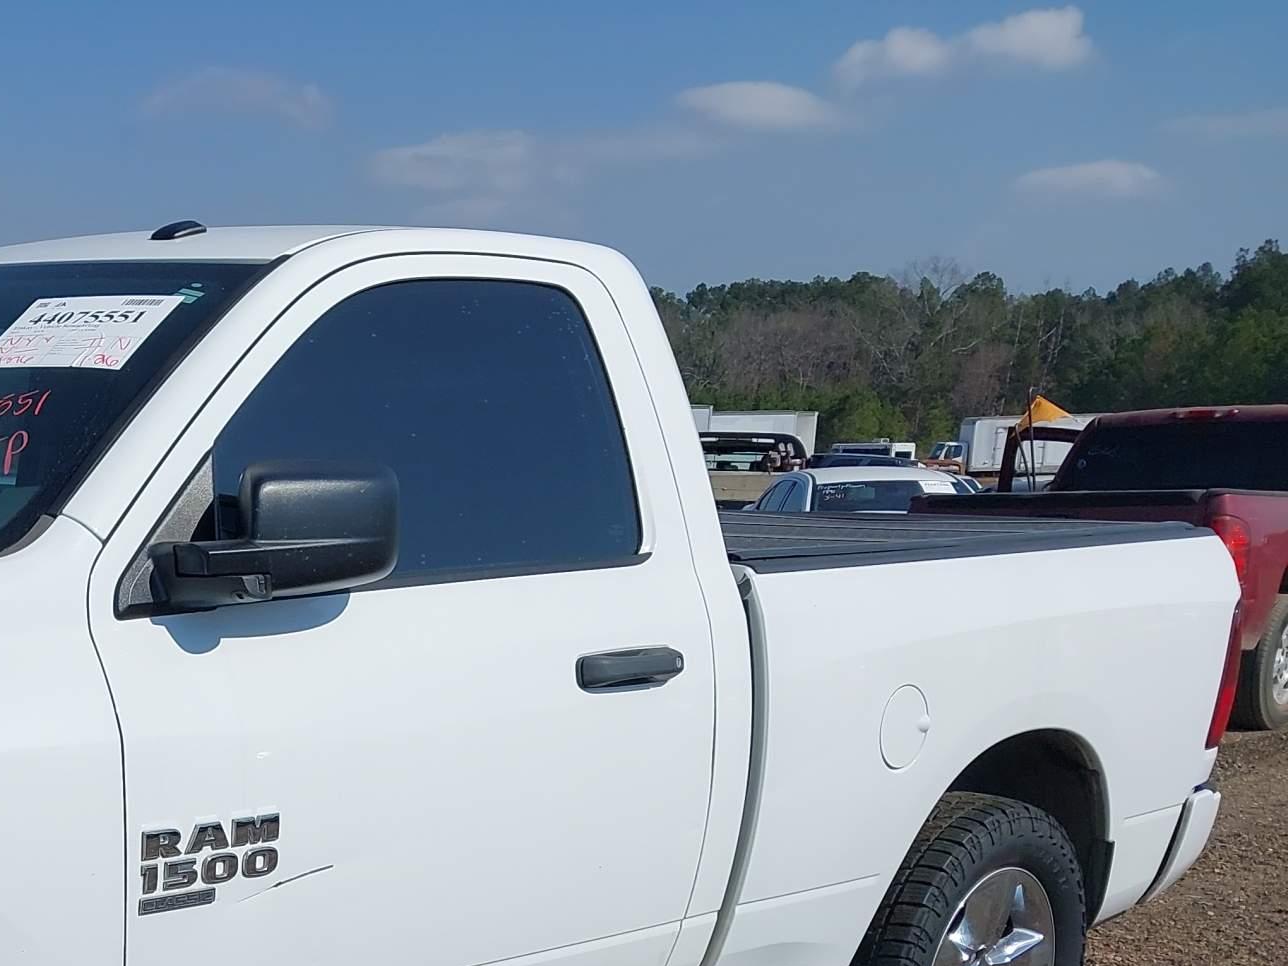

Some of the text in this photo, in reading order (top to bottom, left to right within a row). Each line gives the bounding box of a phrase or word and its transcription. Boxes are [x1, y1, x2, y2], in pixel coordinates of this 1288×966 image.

[28, 310, 148, 325] 44075551
[141, 813, 280, 861] RAM
[140, 845, 280, 895] 1500
